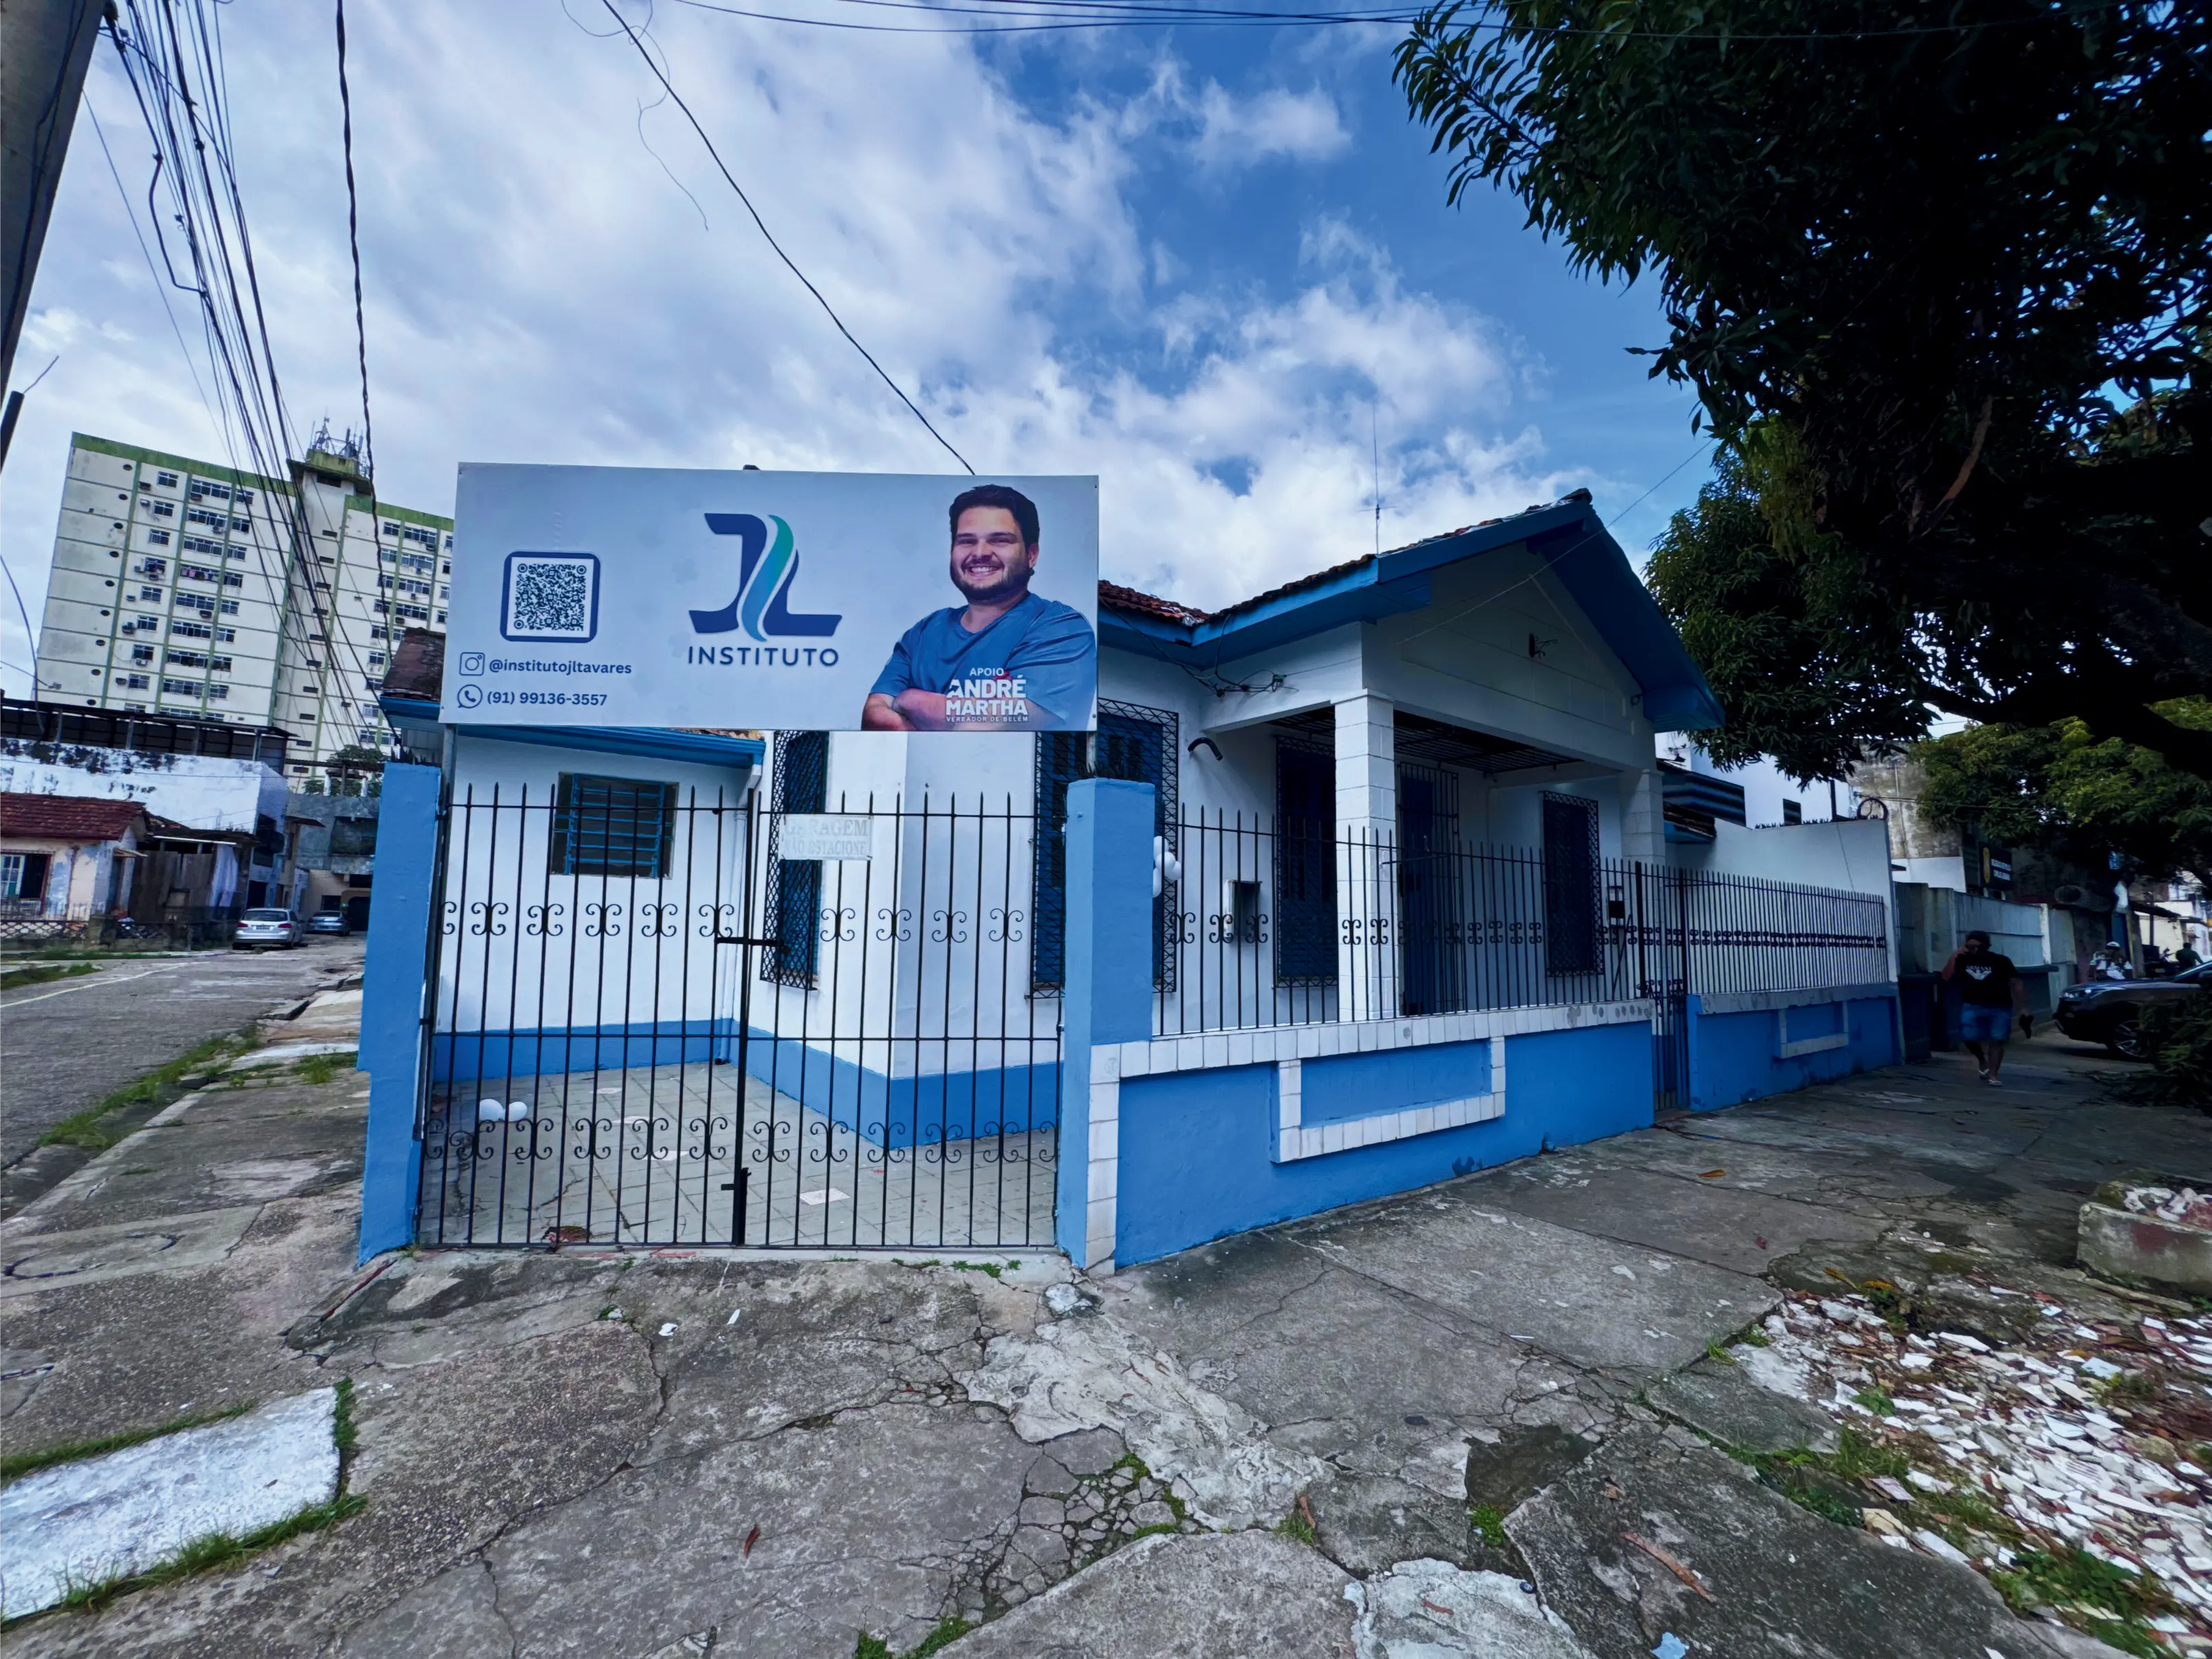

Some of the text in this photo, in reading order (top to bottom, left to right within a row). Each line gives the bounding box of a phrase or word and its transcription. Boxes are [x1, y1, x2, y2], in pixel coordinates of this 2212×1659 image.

[688, 646, 839, 667] INSTITUTO
[489, 658, 632, 676] @institutojltavares
[969, 667, 1005, 676] APOIO
[946, 674, 1026, 698] ANDRÉ
[487, 691, 608, 706] (91) 99136-3557
[946, 700, 1028, 715] MARTHA
[784, 818, 868, 836] GARAGEM
[808, 839, 867, 856] ESTACIONE
